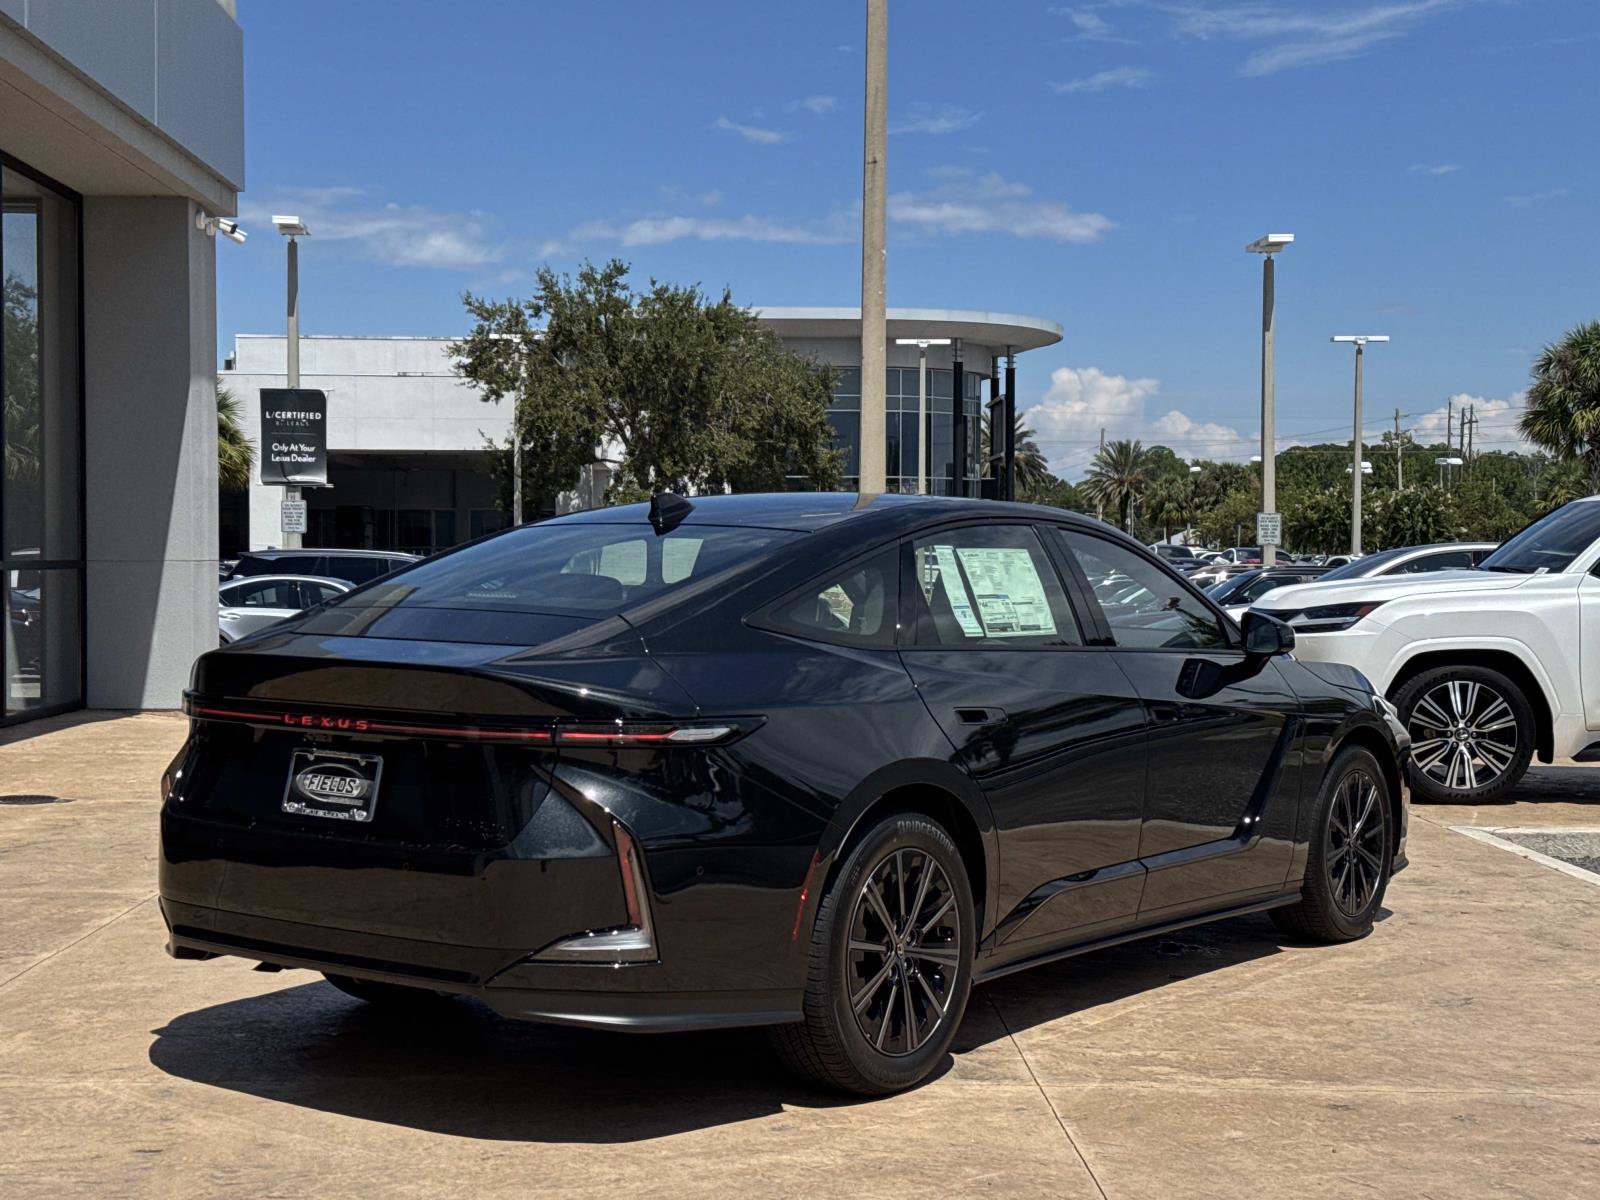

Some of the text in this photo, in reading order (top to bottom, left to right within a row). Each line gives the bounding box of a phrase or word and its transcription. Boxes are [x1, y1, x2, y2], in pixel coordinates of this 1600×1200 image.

[265, 410, 322, 420] L/CERTIFIED
[289, 443, 298, 452] At
[299, 443, 316, 453] Your
[291, 453, 317, 463] Dealer
[284, 714, 369, 731] LEXUS
[306, 773, 357, 795] FIELDS
